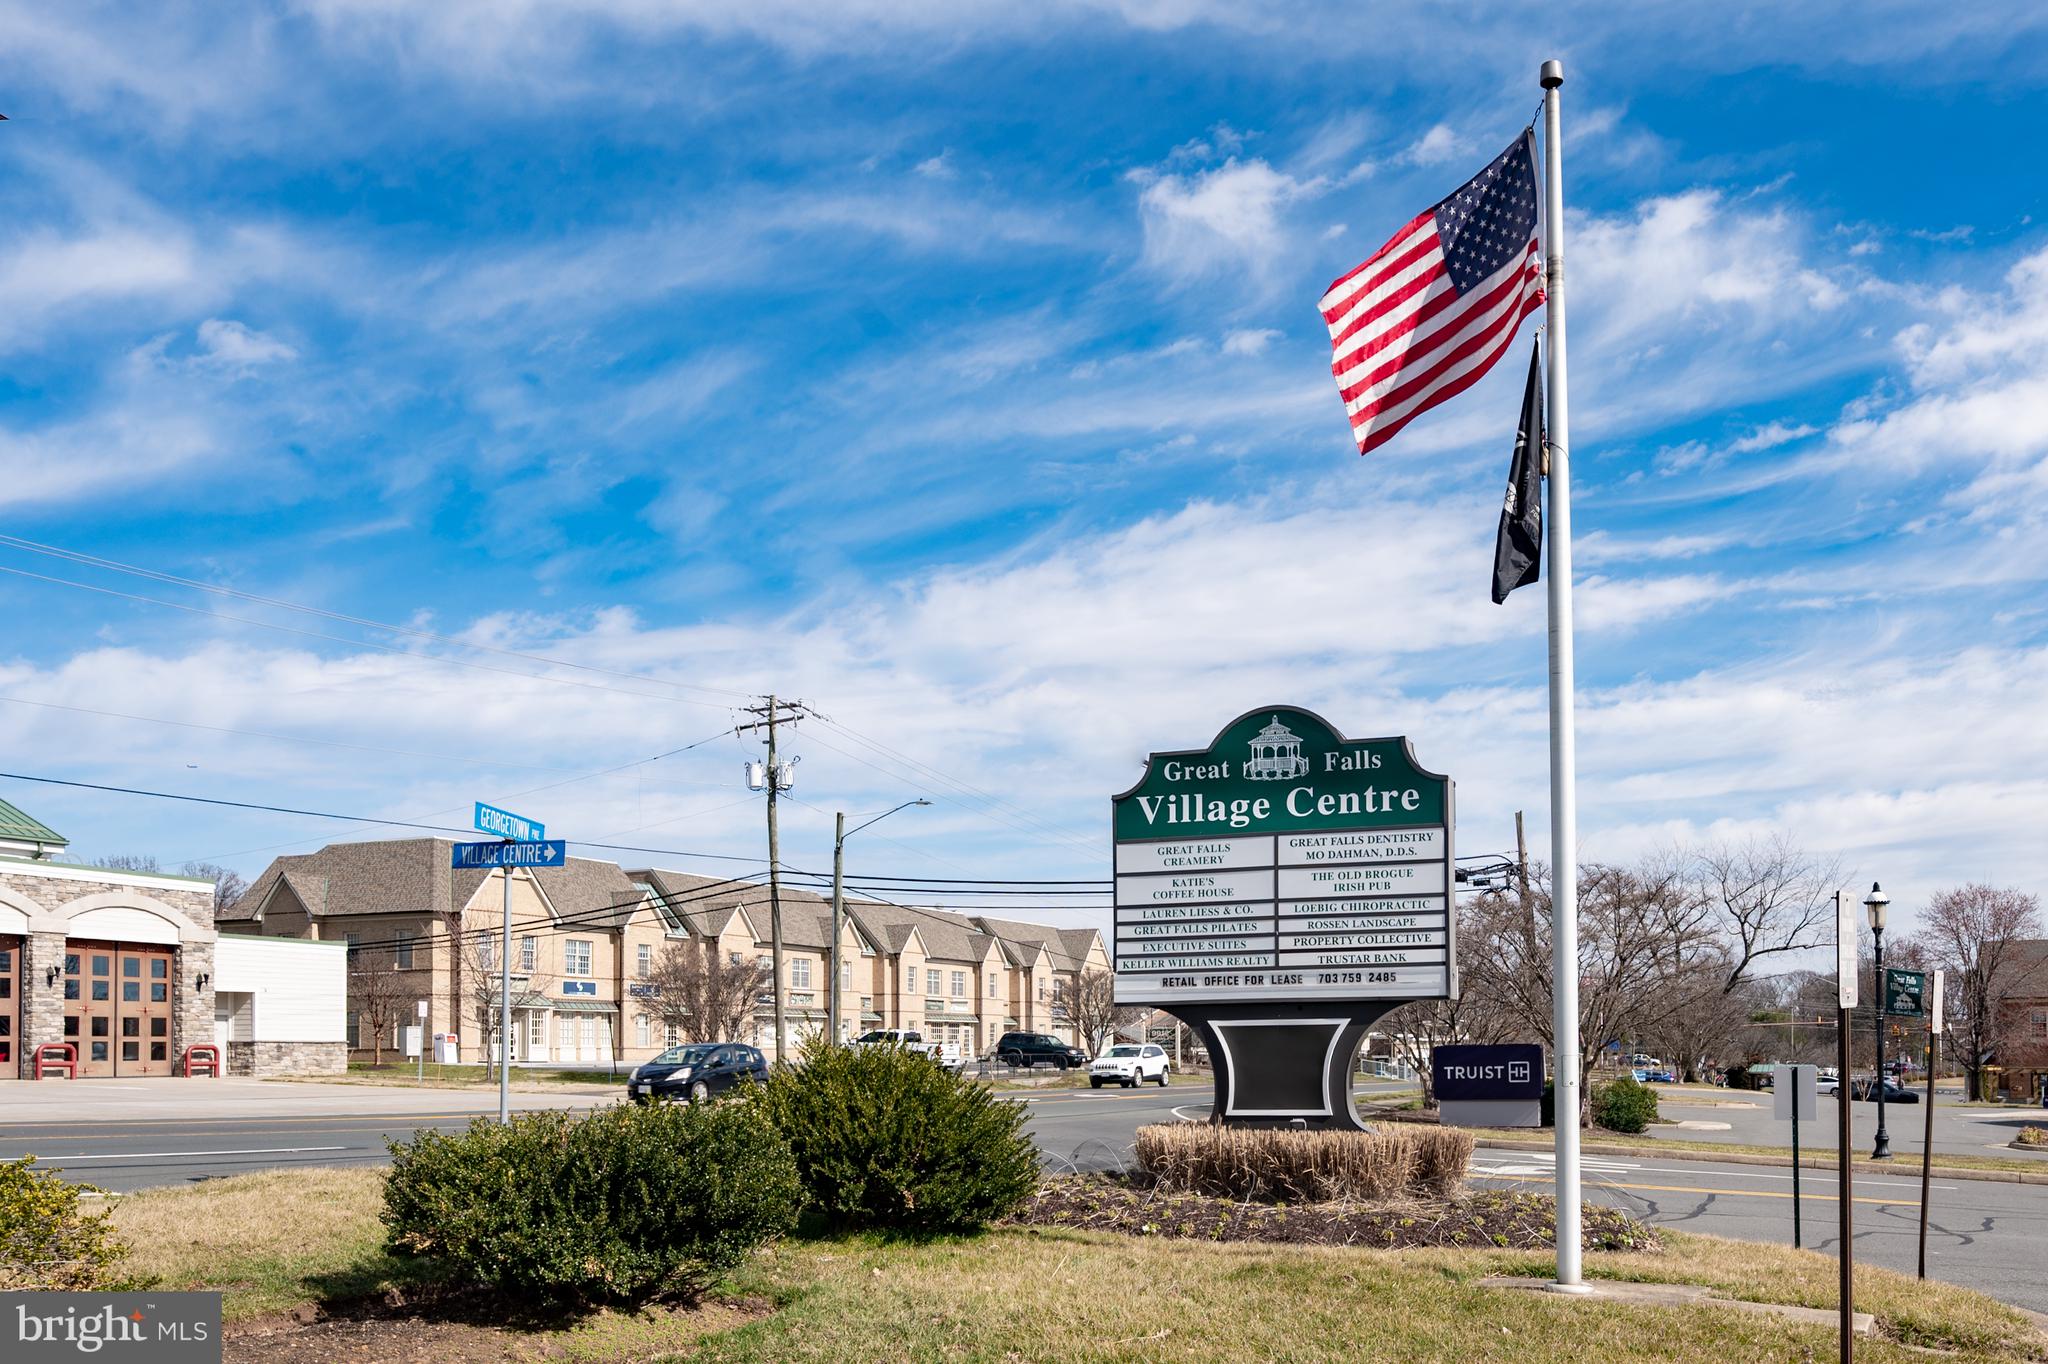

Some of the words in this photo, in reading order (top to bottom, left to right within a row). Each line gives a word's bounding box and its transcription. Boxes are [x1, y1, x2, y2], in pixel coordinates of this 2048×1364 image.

[1164, 761, 1230, 781] Great
[1324, 750, 1381, 771] Falls
[1137, 793, 1270, 827] Village
[1286, 785, 1420, 817] Centre
[480, 807, 530, 840] GEORGETOWN
[1290, 838, 1327, 848] GREAT
[1331, 836, 1364, 845] FALLS
[1368, 833, 1433, 844] DENTISTRY
[462, 846, 499, 864] VILLAGE
[502, 844, 542, 864] CENTRE
[1158, 845, 1193, 855] GREAT
[1197, 844, 1230, 853] FALLS
[1306, 851, 1324, 860] MO
[1328, 849, 1382, 859] DAHMAN,
[1386, 847, 1417, 856] D.D.S.
[1164, 856, 1224, 866] CREAMERY
[1312, 872, 1334, 881] THE
[1338, 871, 1361, 880] OLD
[1365, 869, 1413, 879] BROGUE
[1172, 878, 1214, 887] KATIE'S
[1334, 882, 1365, 892] IRISH
[1369, 881, 1391, 890] PUB
[1153, 890, 1194, 899] COFFEE
[1198, 888, 1234, 897] HOUSE
[1143, 910, 1186, 919] LAUREN
[1190, 908, 1219, 917] LIESS
[1223, 907, 1231, 915] &
[1235, 905, 1253, 914] CO.
[1294, 903, 1337, 913] LOEBIG
[1341, 900, 1430, 911] CHIROPRACTIC
[1134, 926, 1171, 935] GREAT
[1175, 924, 1208, 934] FALLS
[1212, 923, 1257, 932] PILATES
[1307, 920, 1349, 929] ROSSEN
[1352, 918, 1416, 928] LANDSCAPE
[1143, 942, 1205, 952] EXECUTIVE
[1208, 940, 1246, 950] SUITES
[1294, 936, 1354, 946] PROPERTY
[1358, 934, 1431, 944] COLLECTIVE
[1123, 959, 1164, 969] KELLER
[1168, 958, 1223, 968] WILLIAMS
[1227, 956, 1269, 965] REALTY
[1318, 954, 1371, 964] TRUSTAR
[1374, 953, 1407, 962] BANK
[1163, 977, 1197, 987] RETAIL
[1204, 976, 1239, 986] OFFICE
[1245, 975, 1264, 985] FOR
[1271, 975, 1303, 984] LEASE
[1319, 973, 1338, 983] 703
[1342, 973, 1361, 983] 759
[1368, 972, 1397, 982] 2485
[1444, 1065, 1504, 1080] TRUIST
